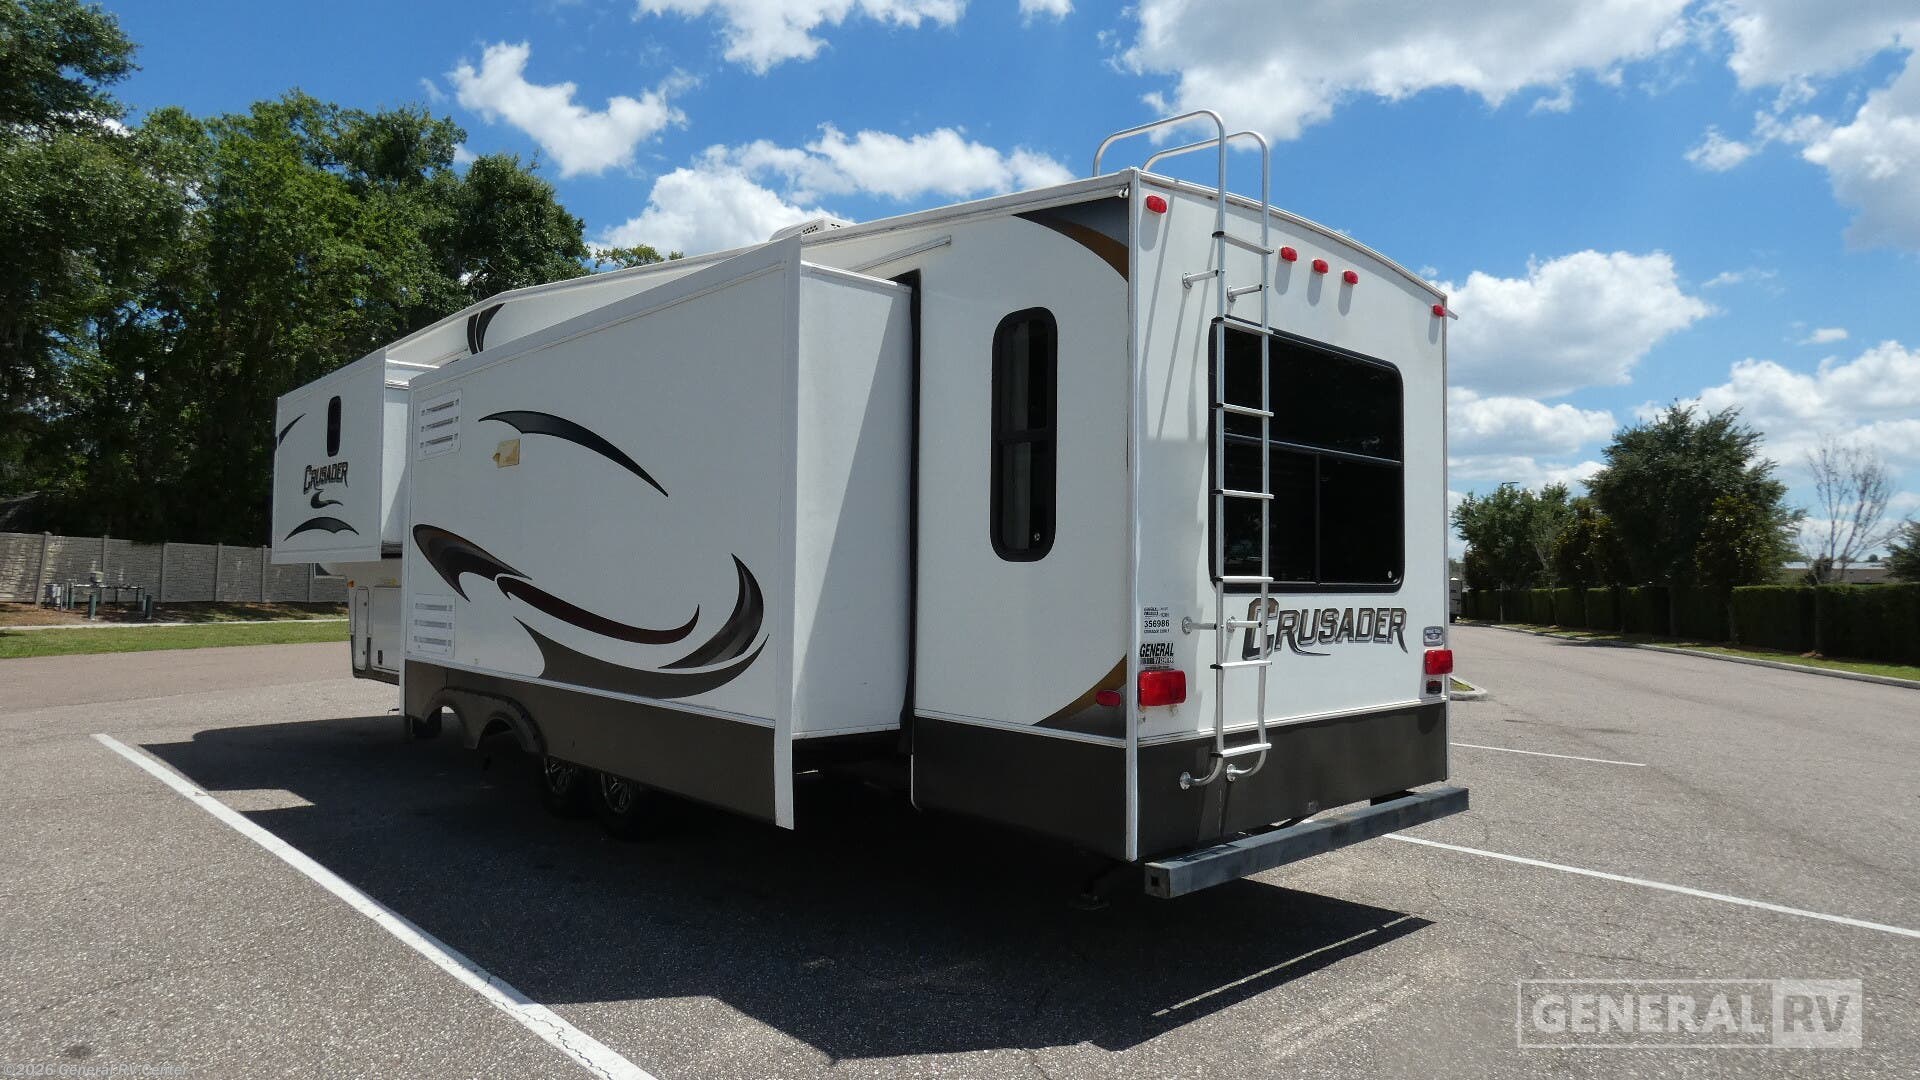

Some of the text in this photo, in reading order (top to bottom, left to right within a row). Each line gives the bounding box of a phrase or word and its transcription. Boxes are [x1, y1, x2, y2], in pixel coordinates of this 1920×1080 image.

[303, 461, 348, 495] CRUSADER
[1143, 619, 1170, 628] 356986
[1242, 598, 1408, 661] CRUSADER
[1139, 642, 1174, 658] GENERAL
